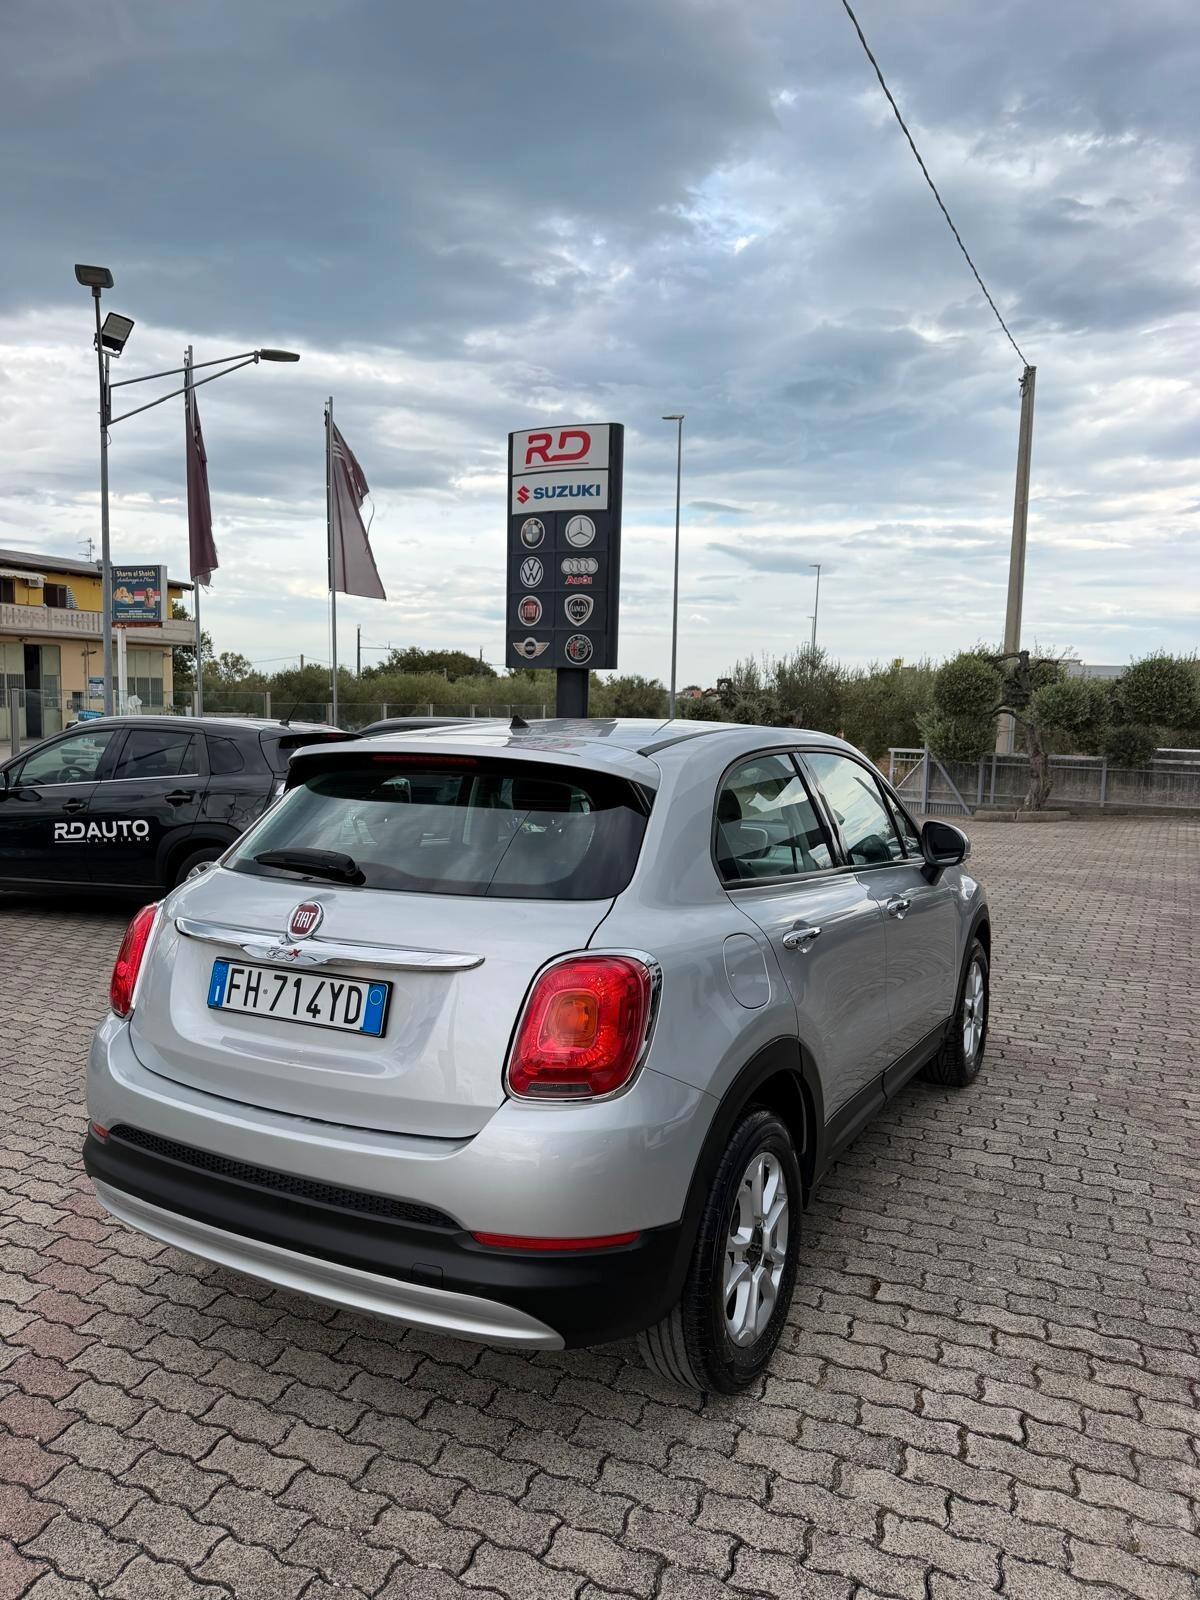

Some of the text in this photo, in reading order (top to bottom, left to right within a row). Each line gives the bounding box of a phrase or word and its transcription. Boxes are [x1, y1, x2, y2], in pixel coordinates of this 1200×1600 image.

[525, 430, 591, 465] RD
[533, 483, 601, 500] SUZUKI
[292, 910, 316, 929] FIAT
